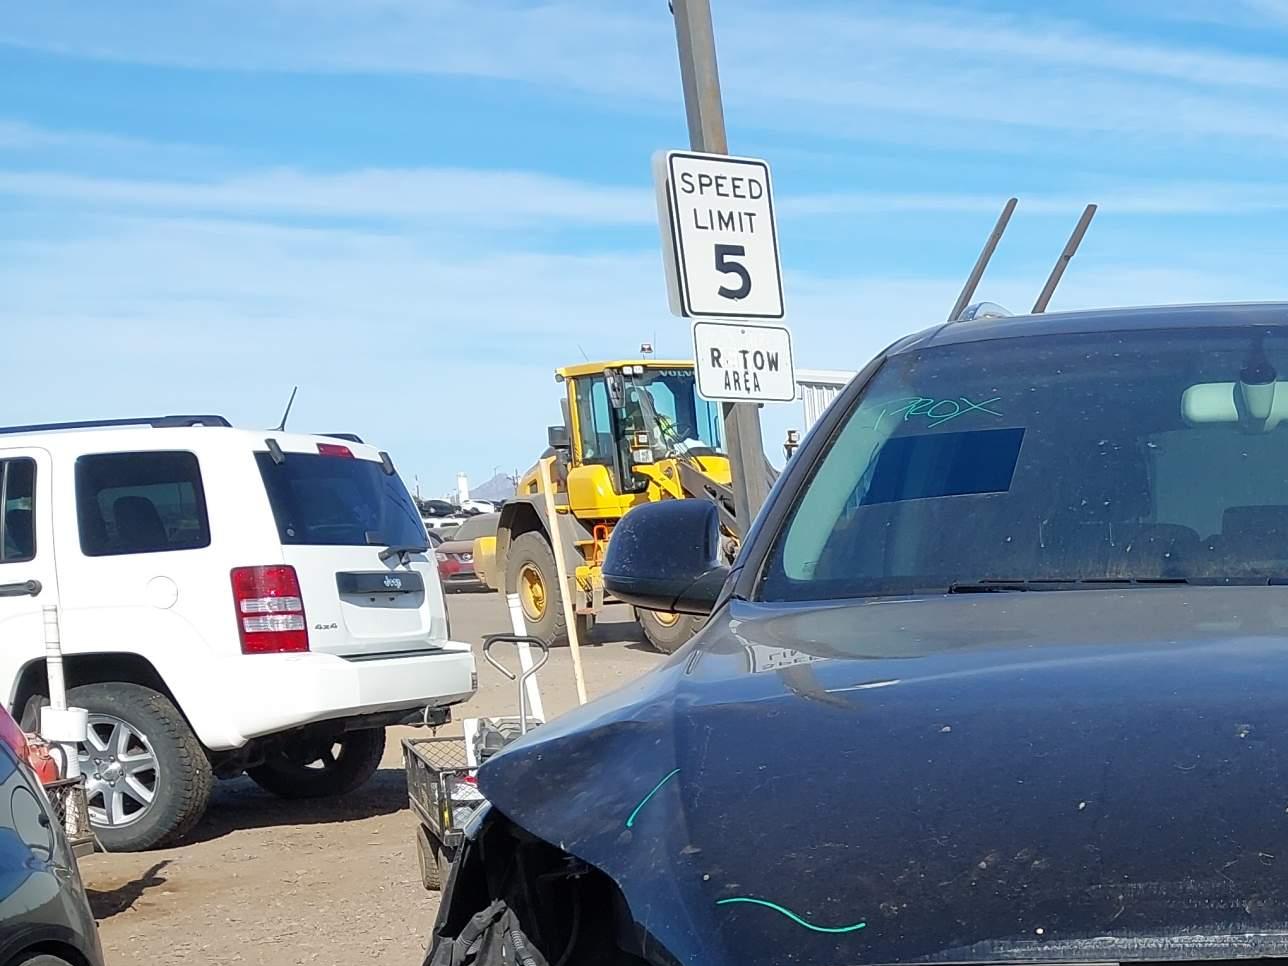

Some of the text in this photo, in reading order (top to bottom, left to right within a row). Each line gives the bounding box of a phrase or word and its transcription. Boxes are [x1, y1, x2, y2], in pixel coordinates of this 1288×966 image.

[681, 172, 763, 200] SPEED
[693, 207, 757, 233] LIMIT
[714, 243, 752, 301] 5
[659, 369, 695, 377] VOLV
[739, 350, 779, 372] TOW
[724, 370, 761, 394] AREA
[384, 575, 402, 588] Jeep
